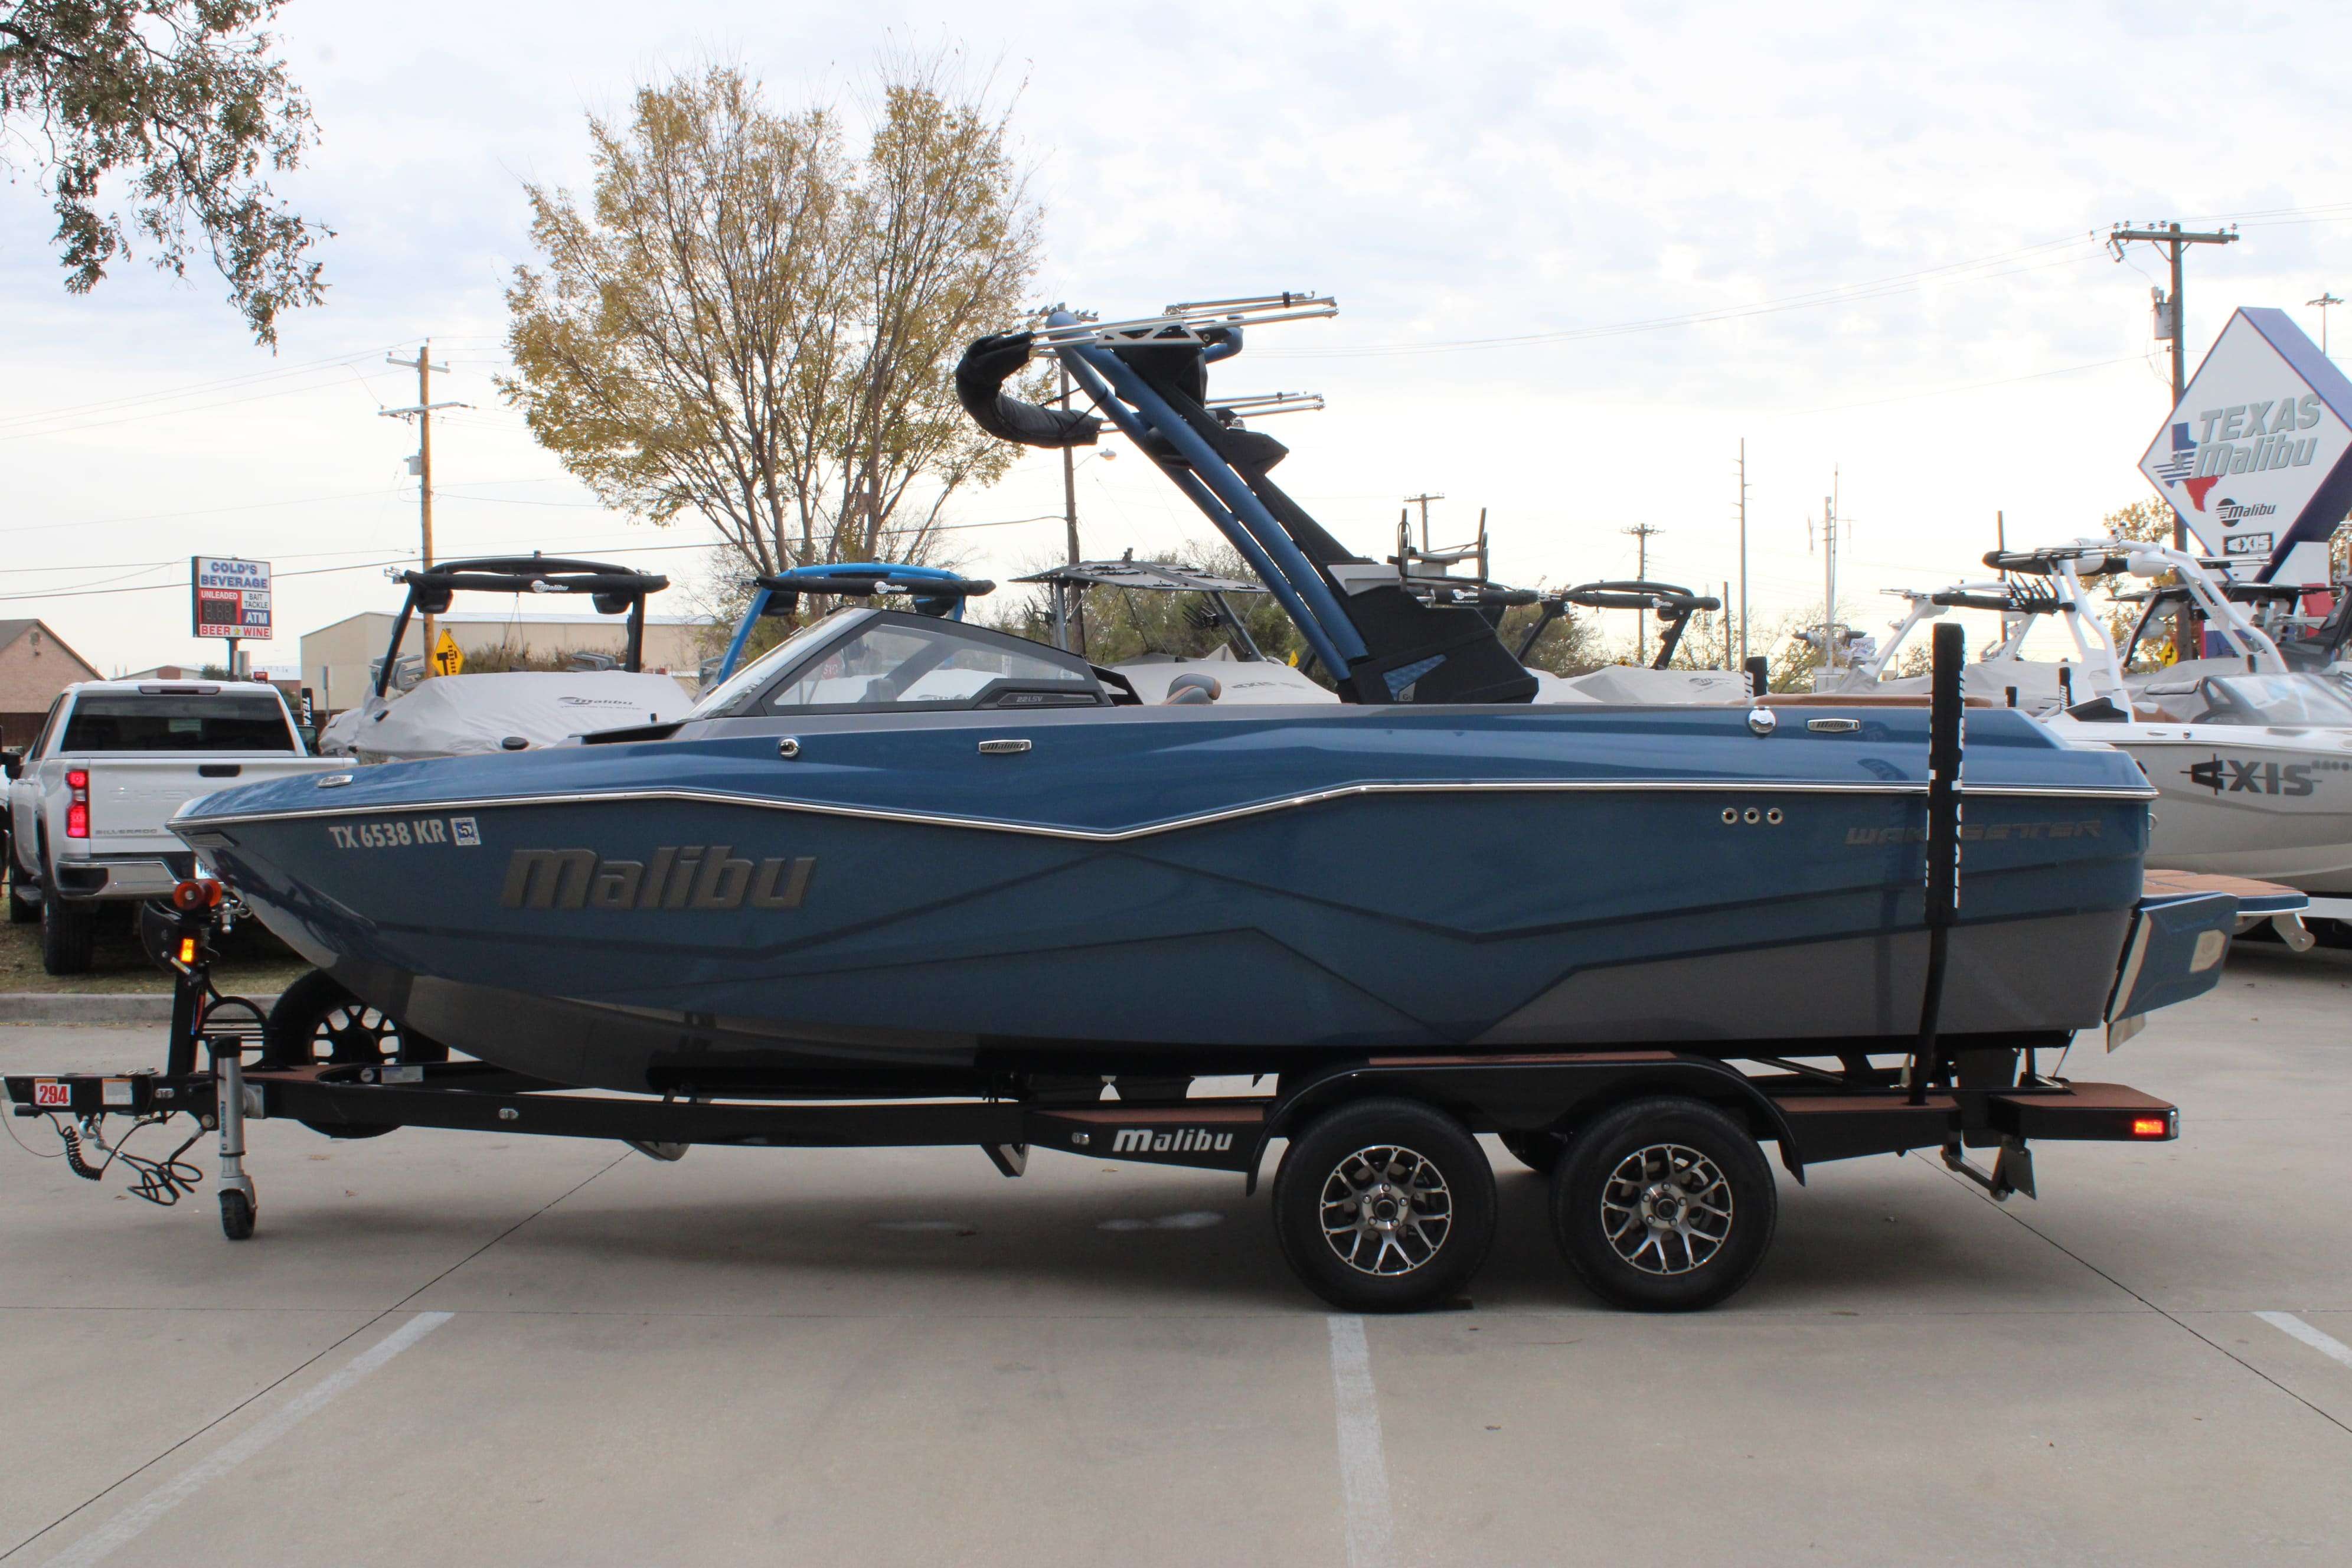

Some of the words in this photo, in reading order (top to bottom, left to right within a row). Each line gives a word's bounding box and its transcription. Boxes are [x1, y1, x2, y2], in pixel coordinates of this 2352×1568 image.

[2199, 394, 2321, 443] TEXAS
[2190, 434, 2318, 479] Malibu
[2227, 534, 2270, 554] AXIS
[211, 561, 257, 575] COLD'S
[201, 574, 267, 589] BEVERAGE
[201, 590, 239, 600] UNLEADED
[244, 600, 268, 609] TACKLE
[246, 612, 267, 624] ATM
[201, 625, 230, 636] BEER
[244, 627, 269, 637] WINE
[302, 697, 312, 725] TEXA
[2191, 759, 2313, 796] AXIS
[328, 826, 359, 848] TX
[361, 822, 411, 848] 6538
[413, 819, 447, 844] KR
[500, 846, 816, 910] Malibu
[40, 1085, 68, 1104] 294
[1112, 1129, 1233, 1152] Malibu
